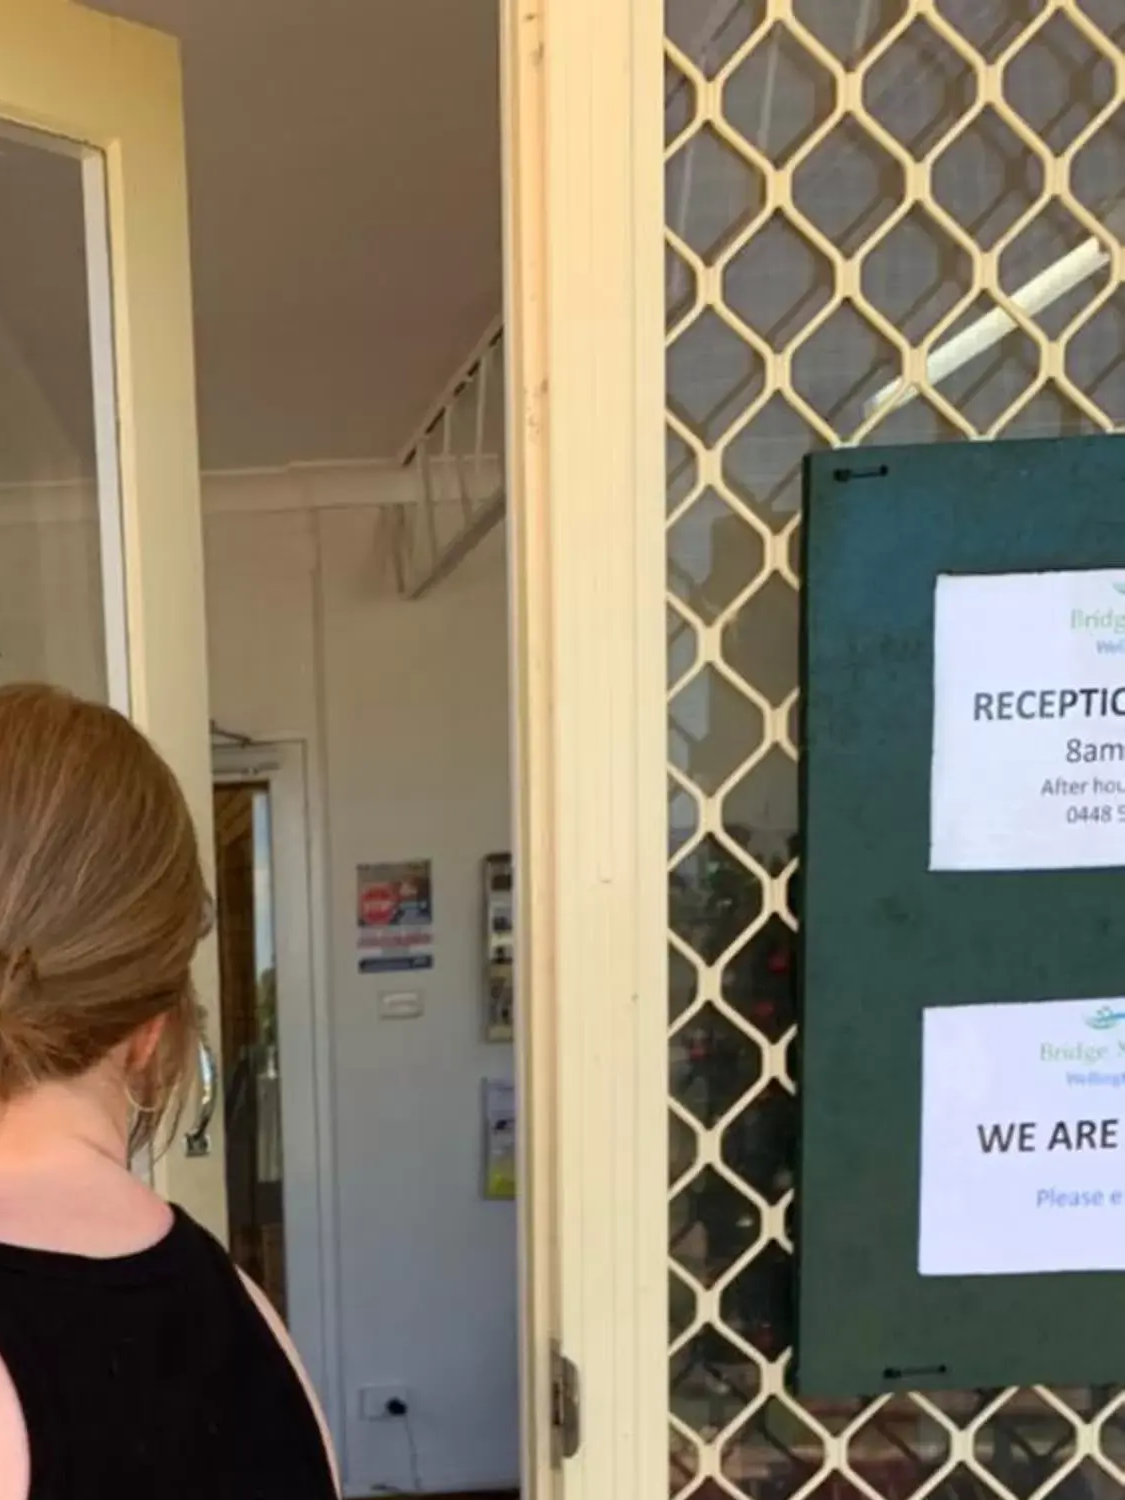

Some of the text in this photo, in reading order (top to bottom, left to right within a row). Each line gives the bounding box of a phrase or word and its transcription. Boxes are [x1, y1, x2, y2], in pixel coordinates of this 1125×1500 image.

[1040, 776, 1089, 797] After
[1066, 805, 1112, 824] 0448
[977, 1119, 1119, 1153] WE ARE
[1036, 1186, 1104, 1208] Please
